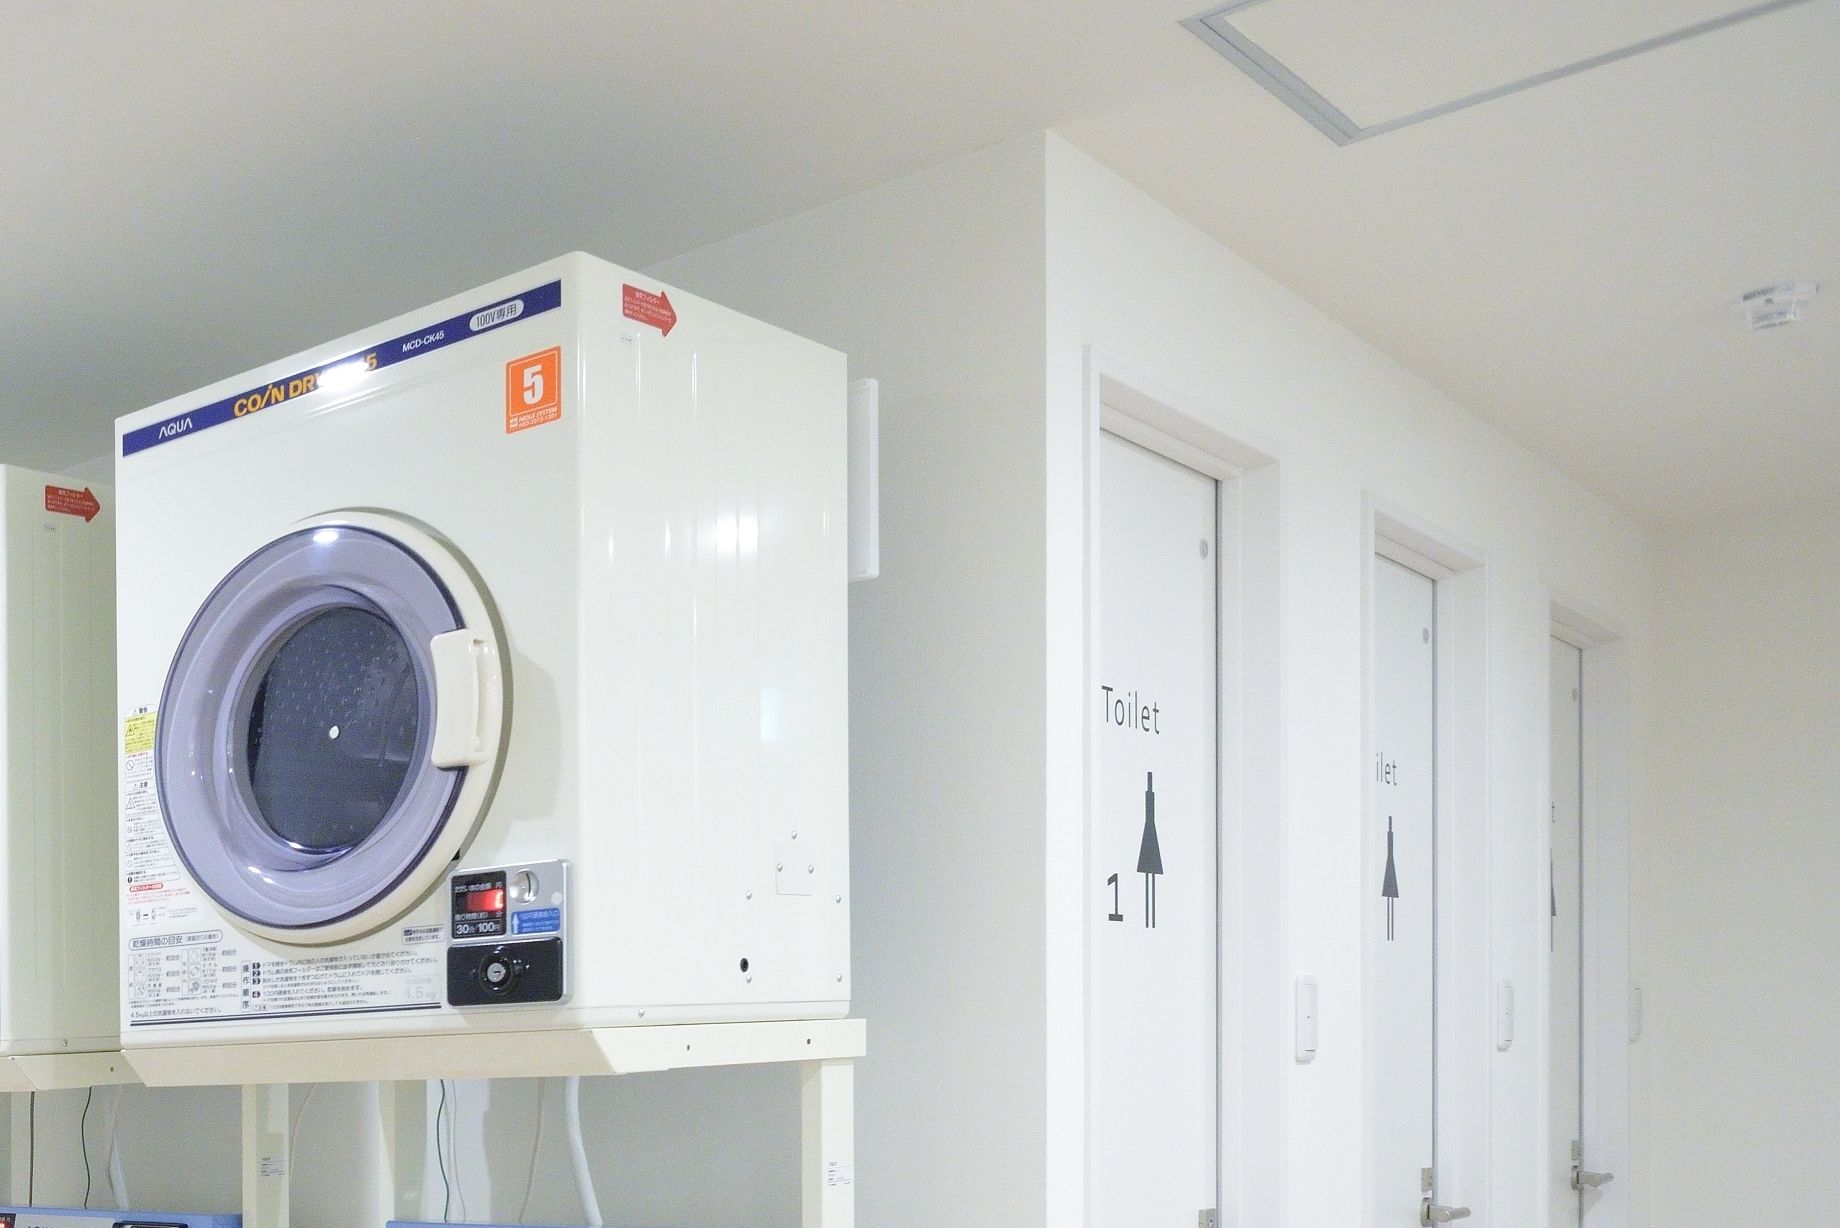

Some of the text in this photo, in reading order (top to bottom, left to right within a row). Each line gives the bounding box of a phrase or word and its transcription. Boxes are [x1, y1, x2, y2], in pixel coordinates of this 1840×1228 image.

[402, 330, 445, 352] MCD-CK45
[233, 383, 285, 418] COIN
[522, 363, 544, 405] 5
[158, 418, 193, 440] AQUA
[1101, 685, 1160, 735] Toilet
[1376, 751, 1398, 786] ilet
[1106, 872, 1124, 922] 1
